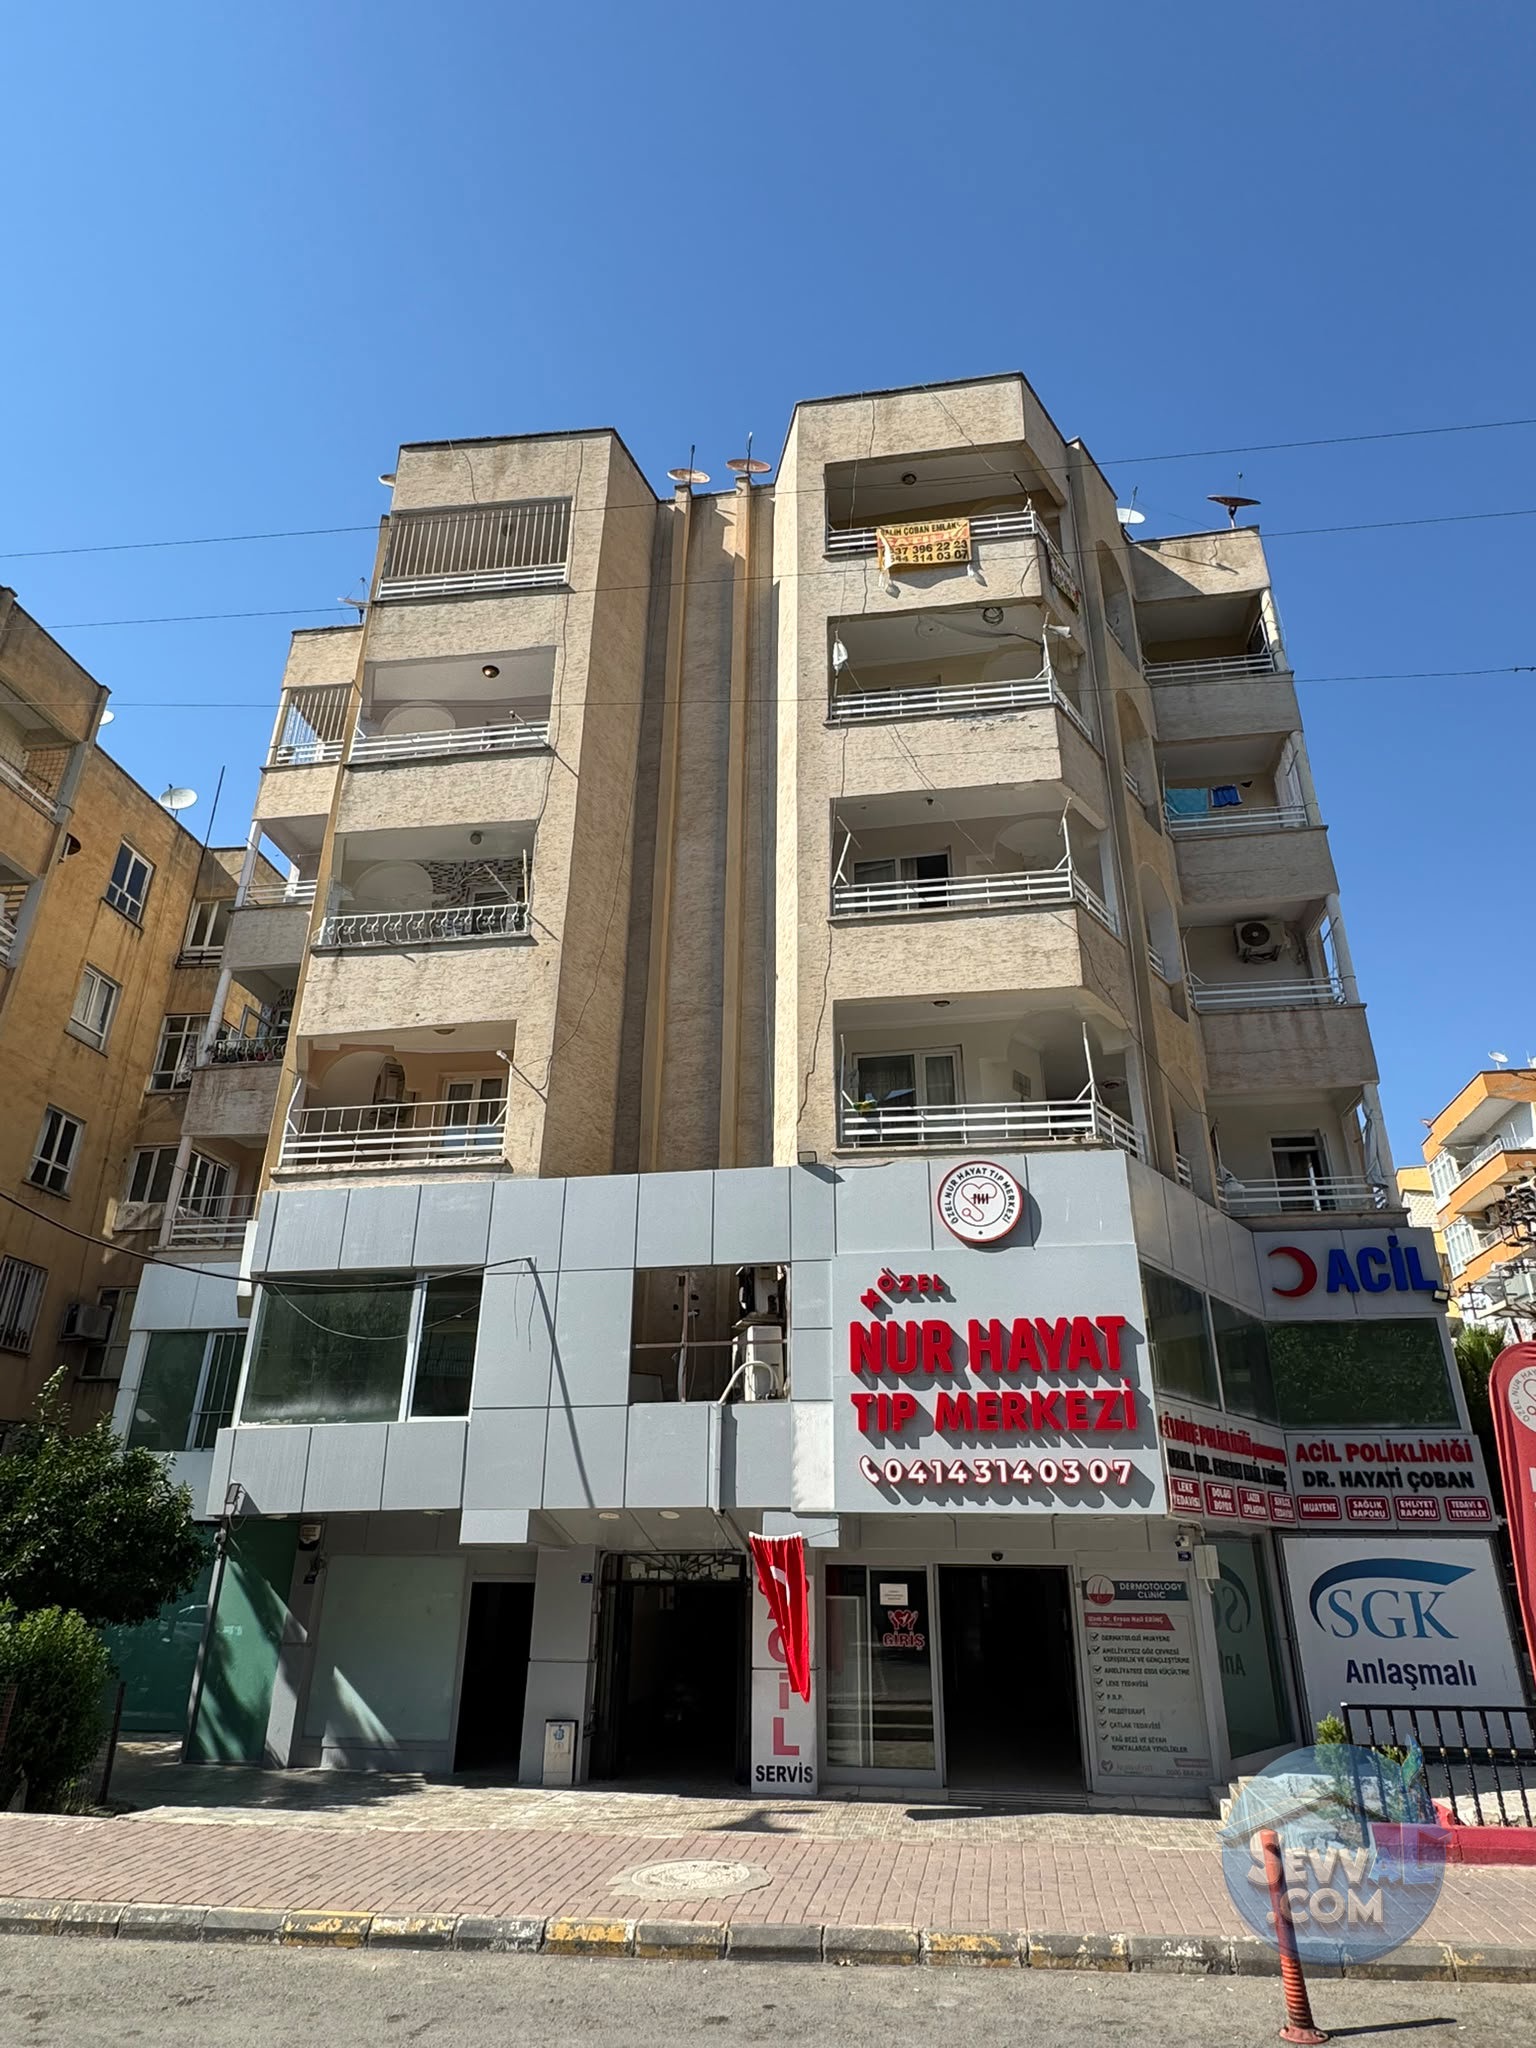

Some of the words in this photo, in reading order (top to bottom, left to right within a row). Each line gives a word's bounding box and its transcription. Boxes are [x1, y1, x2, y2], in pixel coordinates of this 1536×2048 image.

[912, 544, 933, 554] 396
[936, 542, 951, 551] 22
[954, 539, 968, 549] 23
[912, 553, 933, 563] 314
[936, 551, 951, 561] 03
[954, 549, 969, 560] 07
[944, 1179, 959, 1199] NUR
[956, 1167, 988, 1181] HAYAT
[989, 1169, 1005, 1182] TIP
[1326, 1235, 1439, 1293] ACİL
[876, 1267, 944, 1293] ÖZEL
[849, 1320, 954, 1374] NUR
[967, 1316, 1127, 1374] HAYAT
[850, 1393, 918, 1432] TIP
[934, 1377, 1137, 1431] MERKEZİ
[1296, 1439, 1342, 1463] ACİL
[1344, 1438, 1474, 1464] POLİKLİNİĞİ
[883, 1459, 1131, 1484] 04143140307
[1302, 1470, 1336, 1488] DR.
[1340, 1466, 1403, 1489] HAYATİ
[1406, 1471, 1475, 1493] ÇOBAN
[1302, 1502, 1337, 1513] MUAYENE
[1352, 1510, 1386, 1518] RAPORU
[1400, 1509, 1436, 1518] RAPORU
[1328, 1589, 1459, 1639] SGK
[882, 1631, 926, 1650] GİRİŞ
[1346, 1658, 1477, 1691] Anlaşmalı
[755, 1762, 813, 1784] SERVİS
